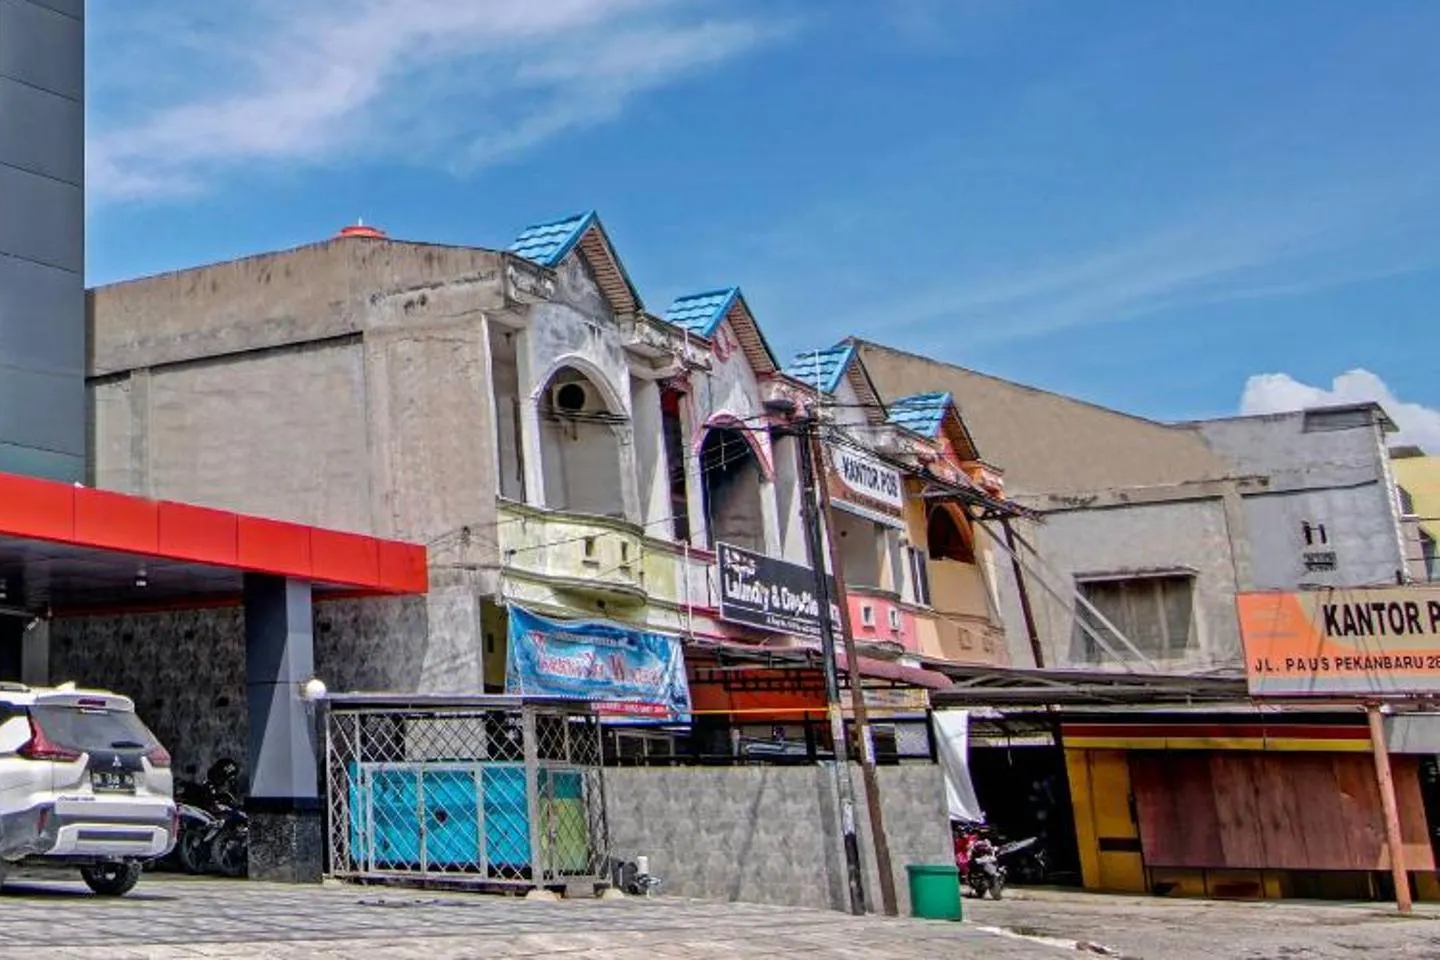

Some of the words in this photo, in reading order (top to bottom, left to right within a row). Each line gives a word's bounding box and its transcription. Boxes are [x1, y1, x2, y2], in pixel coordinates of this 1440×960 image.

[1323, 601, 1423, 636] KANTOR
[1255, 658, 1280, 673] JL.
[1286, 657, 1330, 672] PAUS
[1335, 655, 1424, 672] PEKANBARU
